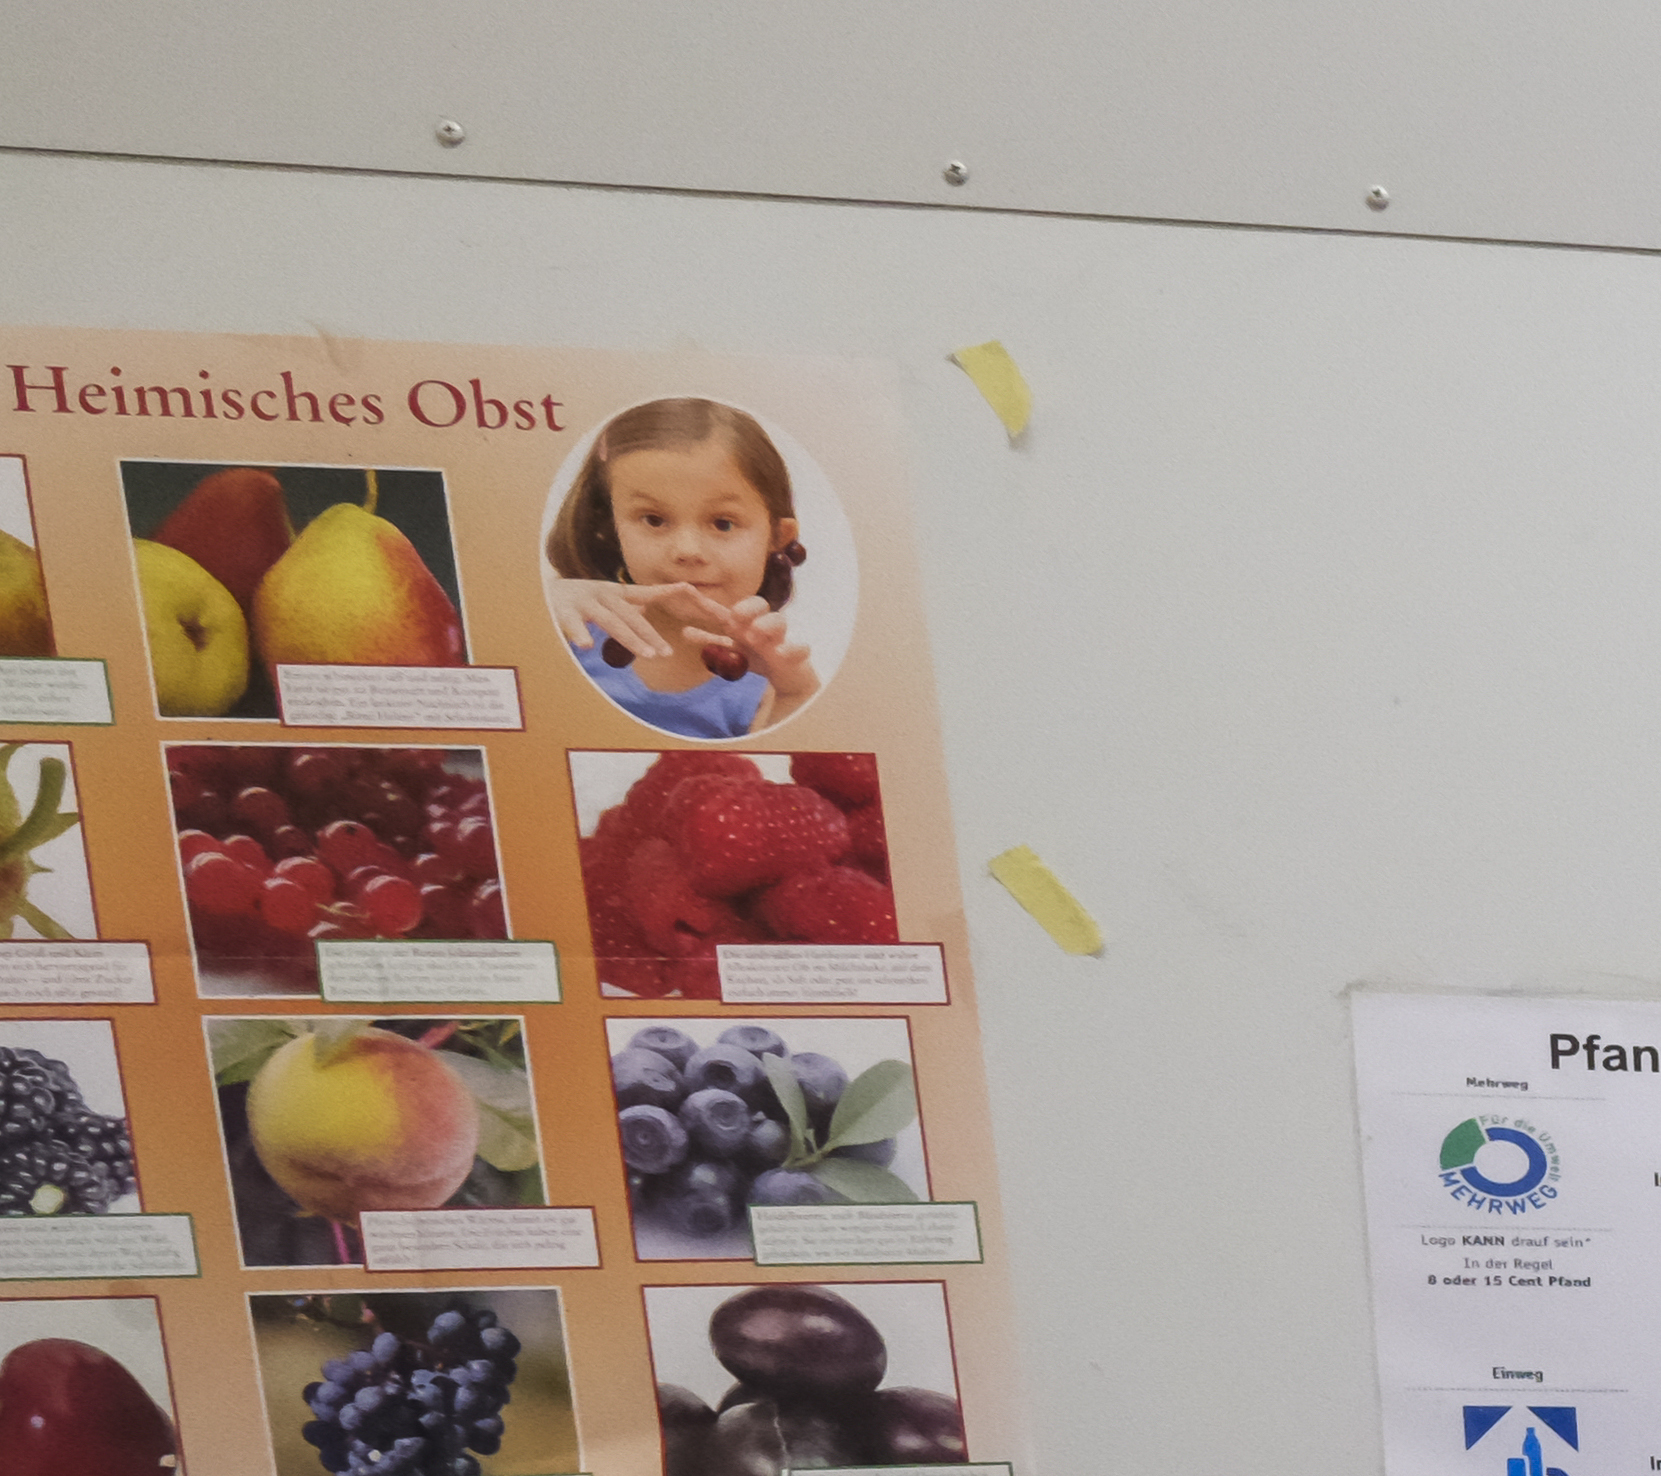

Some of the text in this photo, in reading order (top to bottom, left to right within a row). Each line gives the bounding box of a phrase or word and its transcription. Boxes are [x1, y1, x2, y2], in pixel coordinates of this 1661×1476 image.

[5, 364, 567, 432] Heimisches Obst
[1437, 1170, 1559, 1216] MEHRWEG
[1420, 1233, 1456, 1248] Logo
[1461, 1235, 1505, 1247] KANN
[1511, 1235, 1549, 1248] drauf
[1513, 1257, 1554, 1273] Regel
[1442, 1274, 1477, 1287] oder
[1508, 1275, 1544, 1288] Cent
[1548, 1275, 1592, 1288] Pfand
[1491, 1366, 1544, 1383] Einweg
